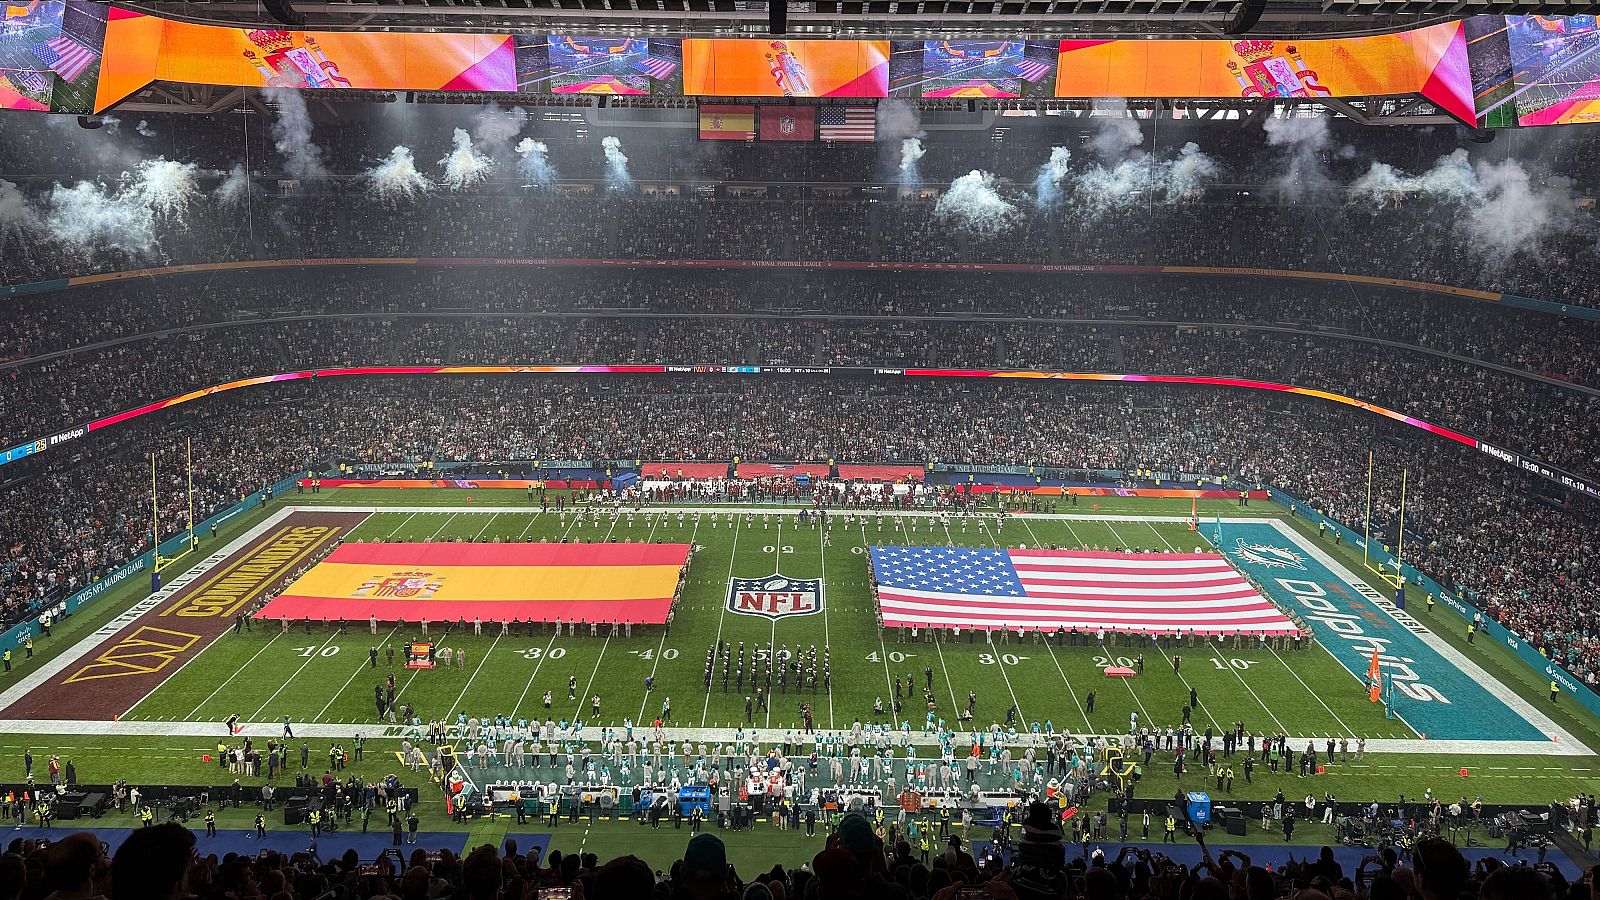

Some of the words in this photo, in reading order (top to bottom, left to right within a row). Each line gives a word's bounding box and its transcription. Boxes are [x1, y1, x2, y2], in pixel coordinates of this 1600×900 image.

[58, 428, 84, 442] NetApp
[1488, 446, 1513, 463] NetApp
[1521, 460, 1539, 473] 15:00
[1561, 475, 1574, 487] 1ST
[1576, 481, 1585, 491] 10
[176, 526, 329, 617] COMMANDERS
[76, 592, 93, 606] 2025
[92, 583, 105, 597] NFL
[104, 569, 127, 589] MADRID
[128, 559, 144, 575] GAME
[96, 627, 118, 636] IT
[115, 595, 165, 623] TAKES
[163, 579, 191, 593] ALL
[738, 592, 812, 613] NFL
[1352, 583, 1380, 599] END
[1376, 601, 1430, 634] RACISM
[1440, 591, 1467, 613] Dolphins
[1507, 636, 1518, 649] VISA
[298, 645, 341, 657] 10
[522, 647, 566, 659] 30
[637, 648, 679, 660] 40
[865, 651, 906, 663] 40
[978, 652, 1020, 665] 30
[1092, 656, 1134, 667] 20
[1209, 656, 1250, 670] 10
[1552, 669, 1578, 692] Santander
